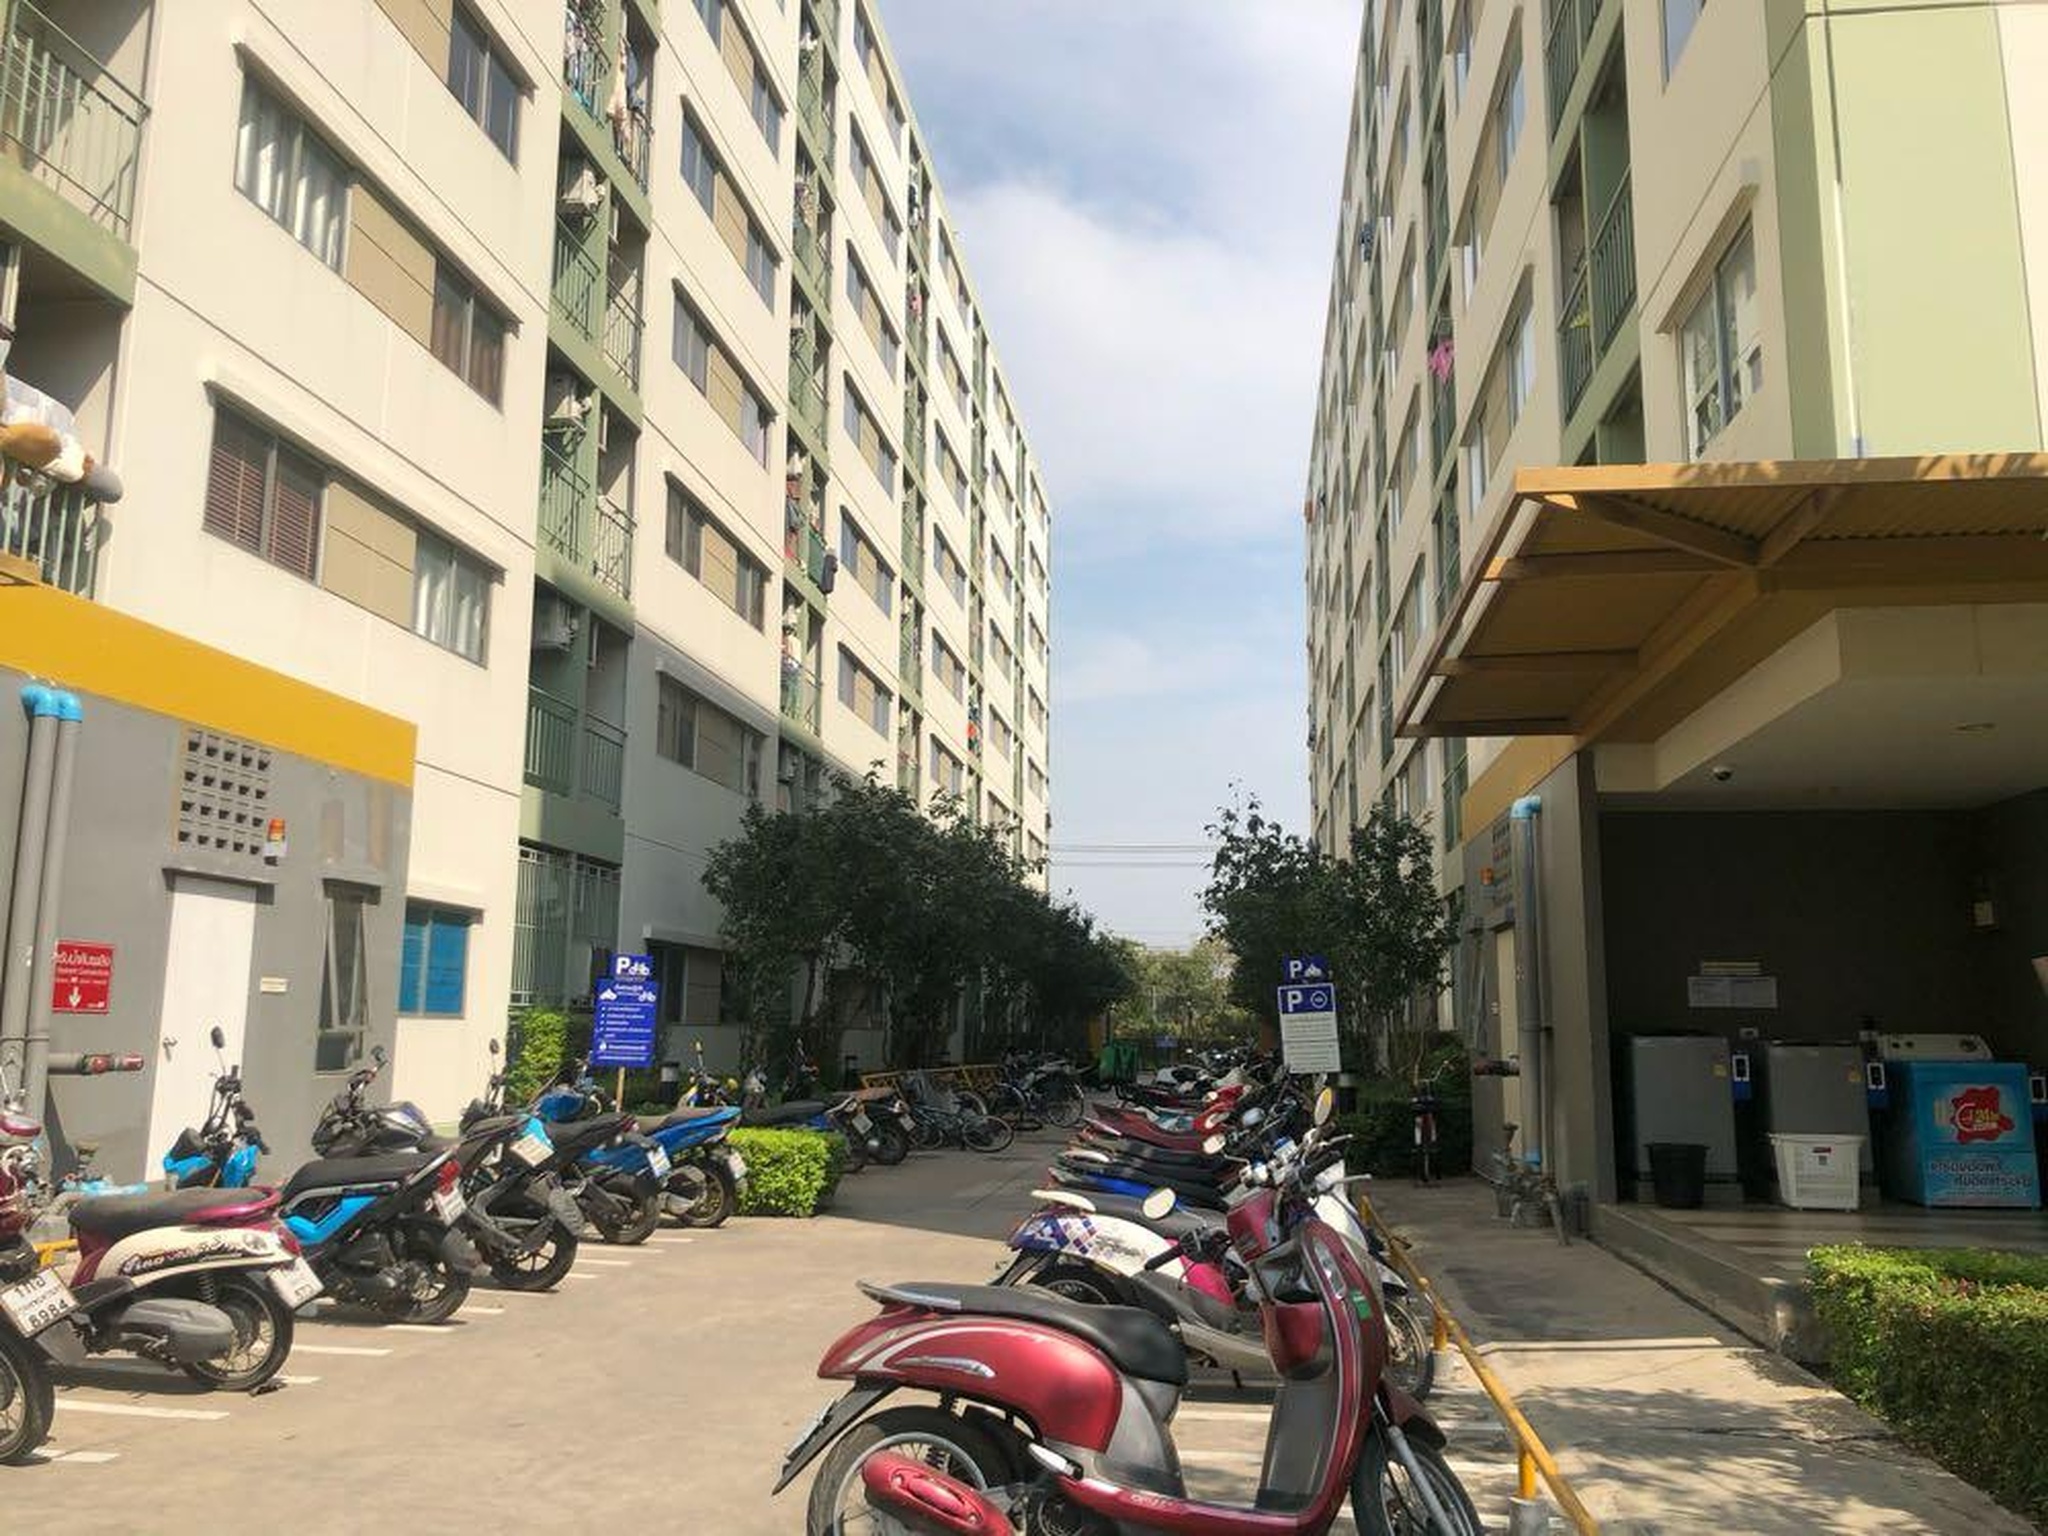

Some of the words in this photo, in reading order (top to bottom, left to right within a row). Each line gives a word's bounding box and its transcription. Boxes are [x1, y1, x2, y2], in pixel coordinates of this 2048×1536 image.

[616, 957, 631, 975] P
[1289, 960, 1302, 979] P
[1287, 990, 1303, 1012] P
